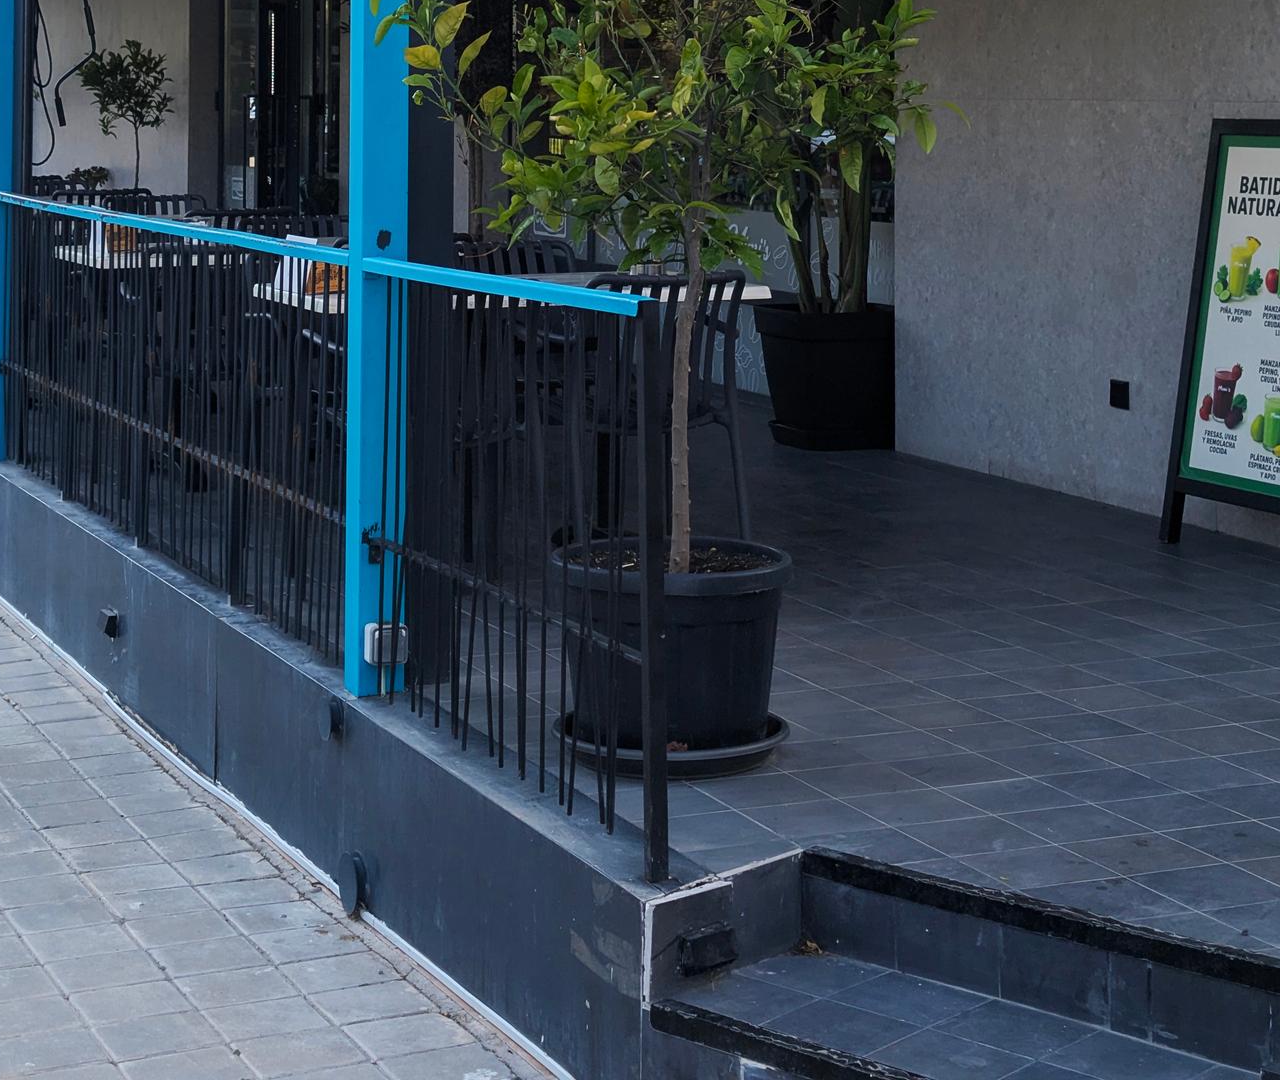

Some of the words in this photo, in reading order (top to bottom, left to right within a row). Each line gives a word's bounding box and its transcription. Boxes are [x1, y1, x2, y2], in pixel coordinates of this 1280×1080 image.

[1263, 320, 1280, 328] CRUDA
[1260, 375, 1278, 385] CRUDA
[1204, 429, 1223, 439] FRESAS,
[1224, 432, 1238, 442] UVAS
[1206, 437, 1236, 449] REMOLACHA
[1209, 446, 1227, 455] COCIDA
[1249, 453, 1275, 465] PLÁTANO,
[1248, 461, 1272, 472] ESPINACA
[1264, 472, 1276, 481] APIO
